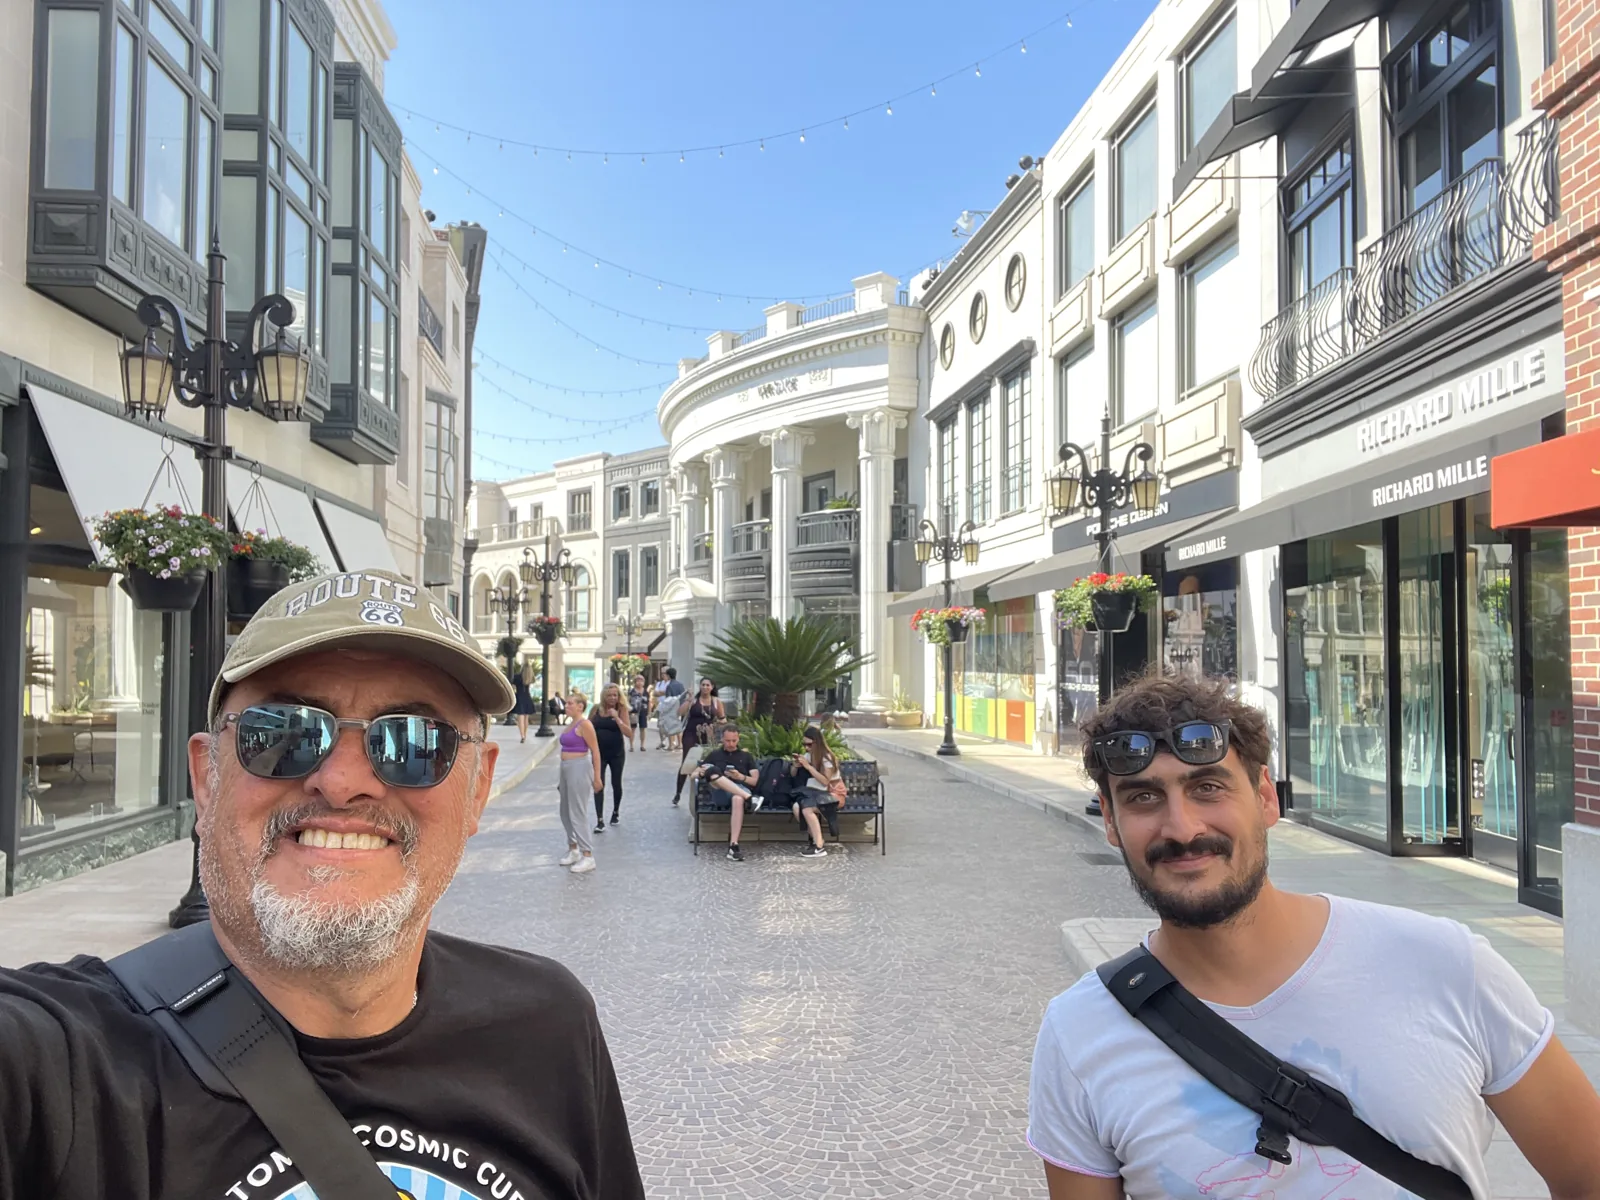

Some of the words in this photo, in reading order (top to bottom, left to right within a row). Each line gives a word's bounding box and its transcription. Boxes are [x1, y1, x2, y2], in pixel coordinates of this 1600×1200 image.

[1357, 391, 1454, 452] RICHARD
[1458, 349, 1547, 414] MILLE
[1372, 472, 1434, 507] RICHARD
[1437, 455, 1488, 489] MILLE
[1086, 513, 1129, 537] POCHE
[1178, 541, 1205, 561] RICHARD
[1205, 535, 1227, 554] MILLE
[285, 573, 417, 618] ROUTE
[428, 602, 466, 643] 66
[364, 608, 400, 625] 66
[366, 600, 399, 613] ROUTE
[352, 1124, 470, 1169] COSMIC
